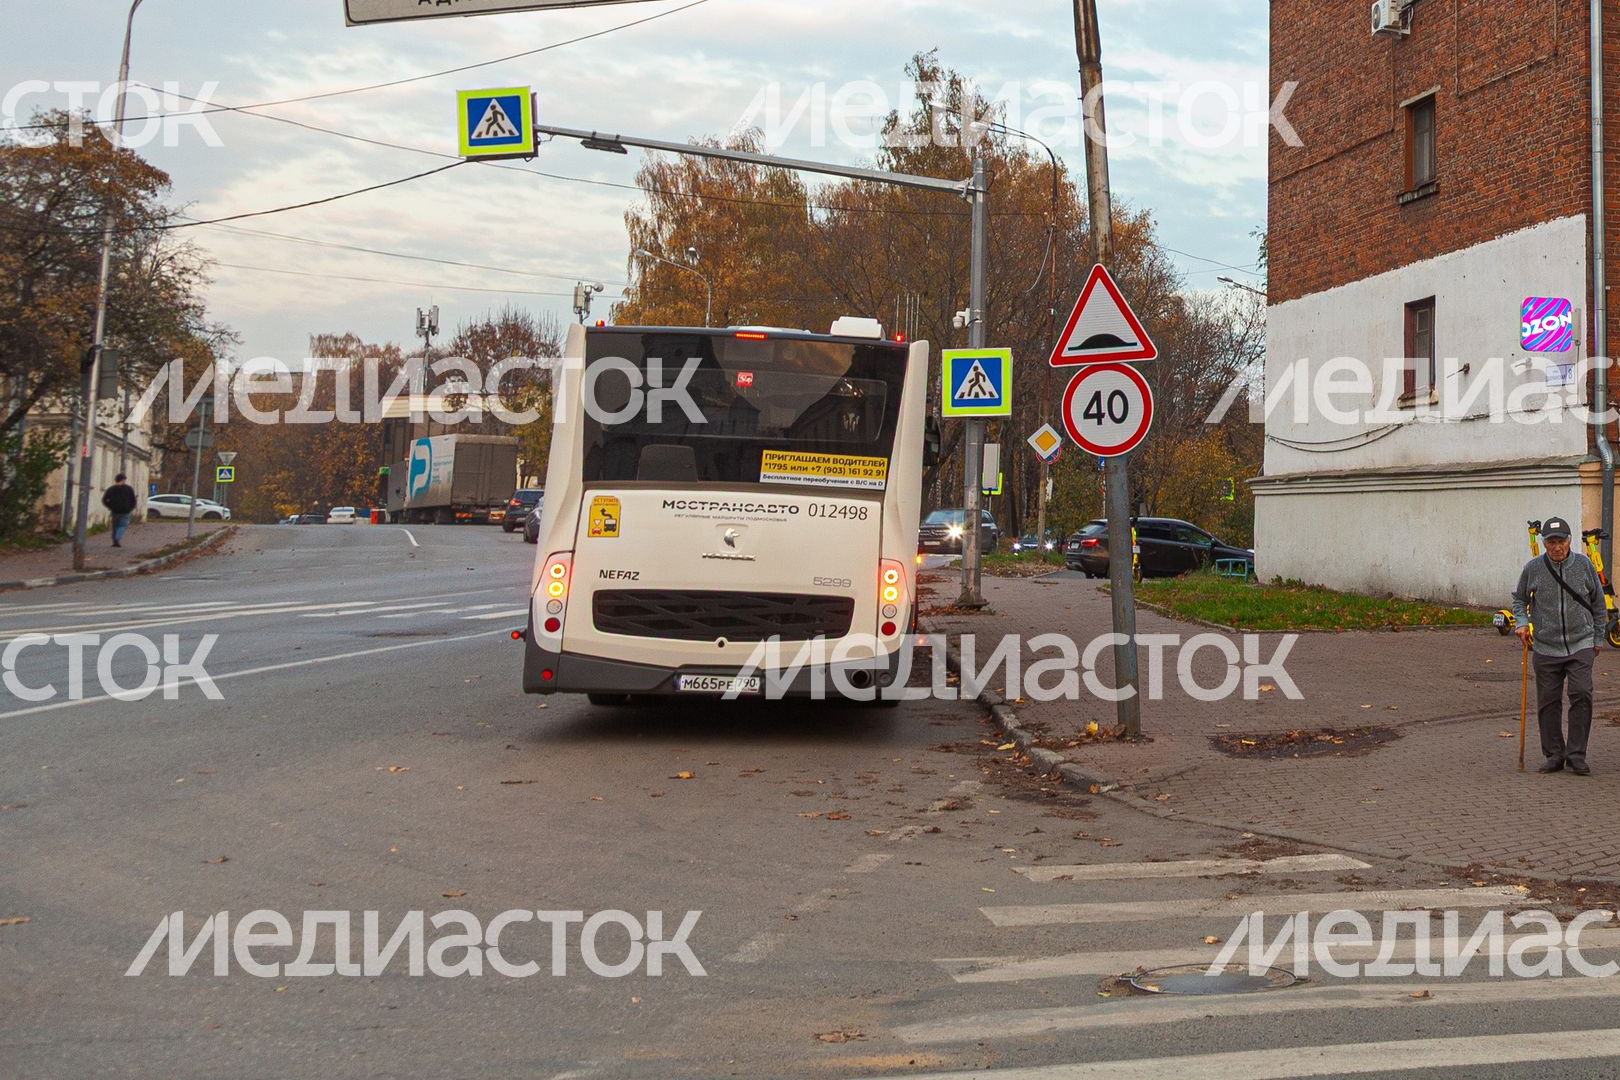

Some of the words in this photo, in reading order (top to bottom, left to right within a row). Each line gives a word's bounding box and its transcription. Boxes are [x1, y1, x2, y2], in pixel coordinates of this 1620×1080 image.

[1083, 389, 1129, 425] 40
[765, 453, 830, 464] ПРИГЛАШАЕМ
[832, 458, 885, 467] ВОДИТЕЛЕЙ
[762, 473, 802, 481] Бесплатное
[823, 466, 846, 476] (903)
[848, 467, 860, 475] 161
[875, 469, 884, 477] 91
[662, 499, 799, 515] МОСТРАНСАВТО
[808, 503, 869, 520] 012498
[599, 569, 640, 580] NEFAZ
[813, 576, 851, 588] 5299
